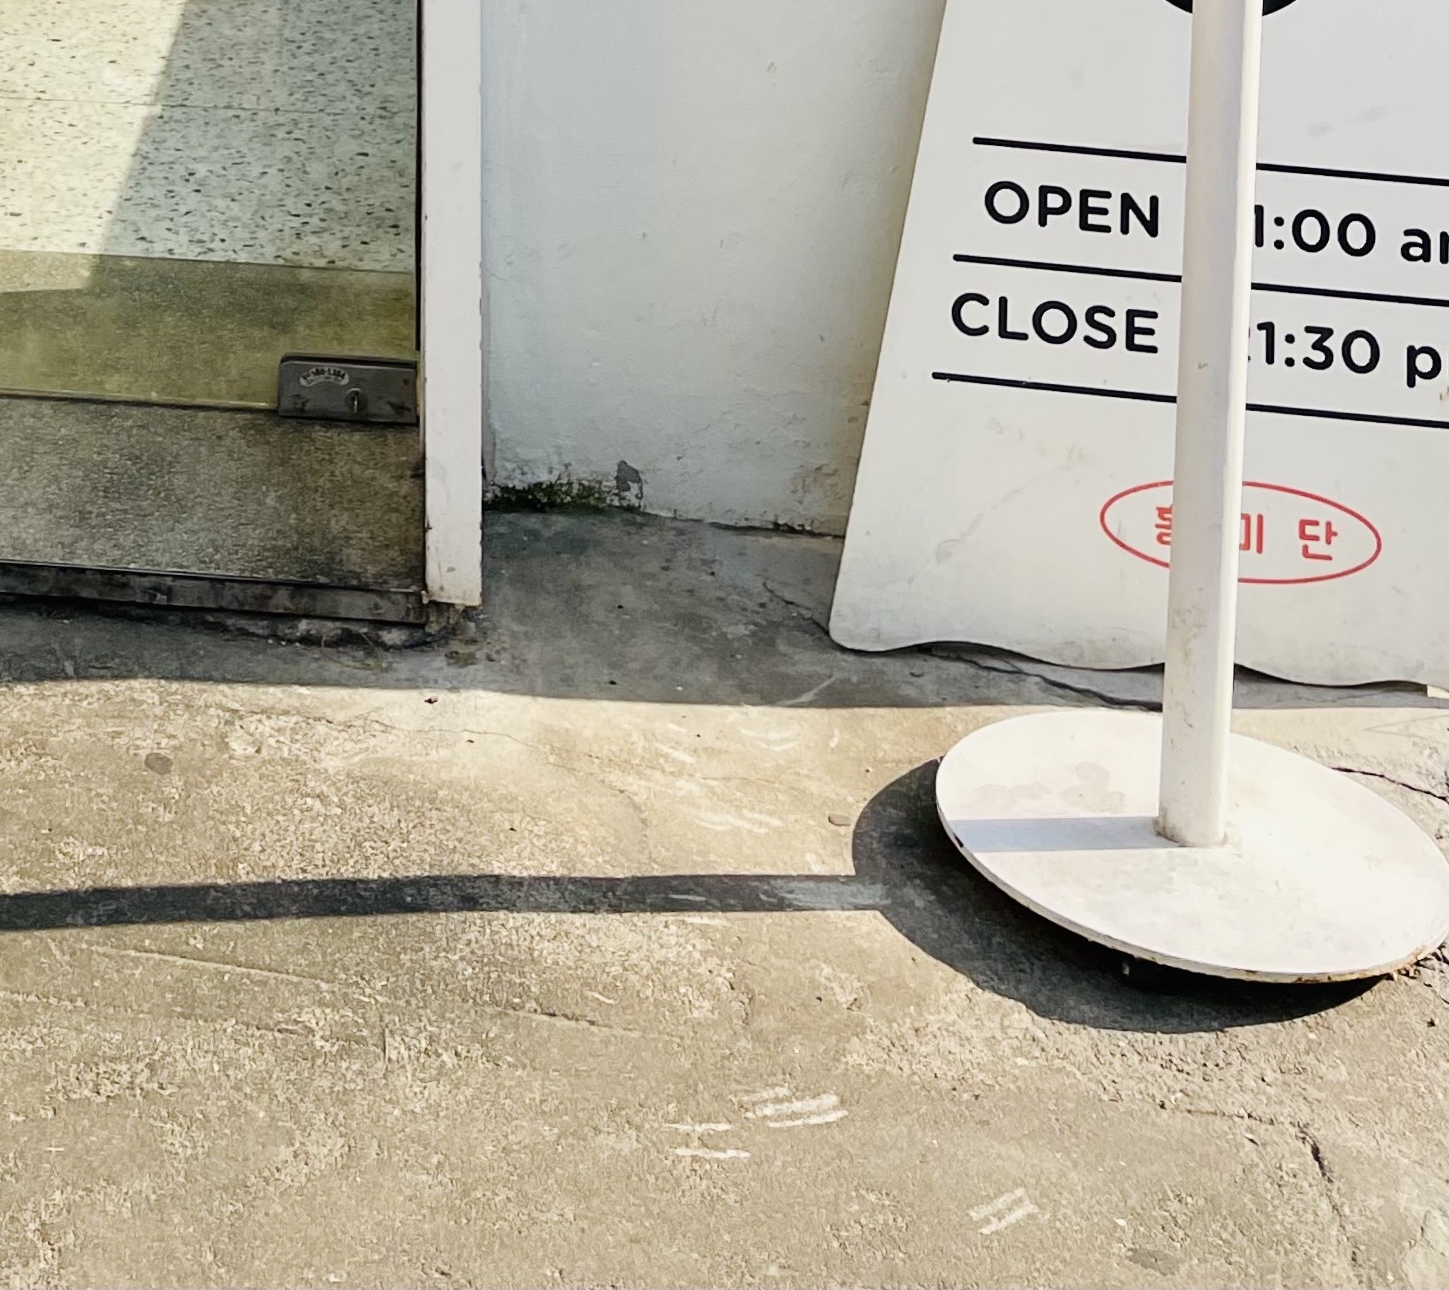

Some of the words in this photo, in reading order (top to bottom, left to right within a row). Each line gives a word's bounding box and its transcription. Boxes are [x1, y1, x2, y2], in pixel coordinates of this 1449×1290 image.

[984, 180, 1159, 238] OPEN
[1253, 204, 1376, 258] 1:00
[951, 292, 1159, 354] CLOSE
[1248, 320, 1381, 375] 1:30
